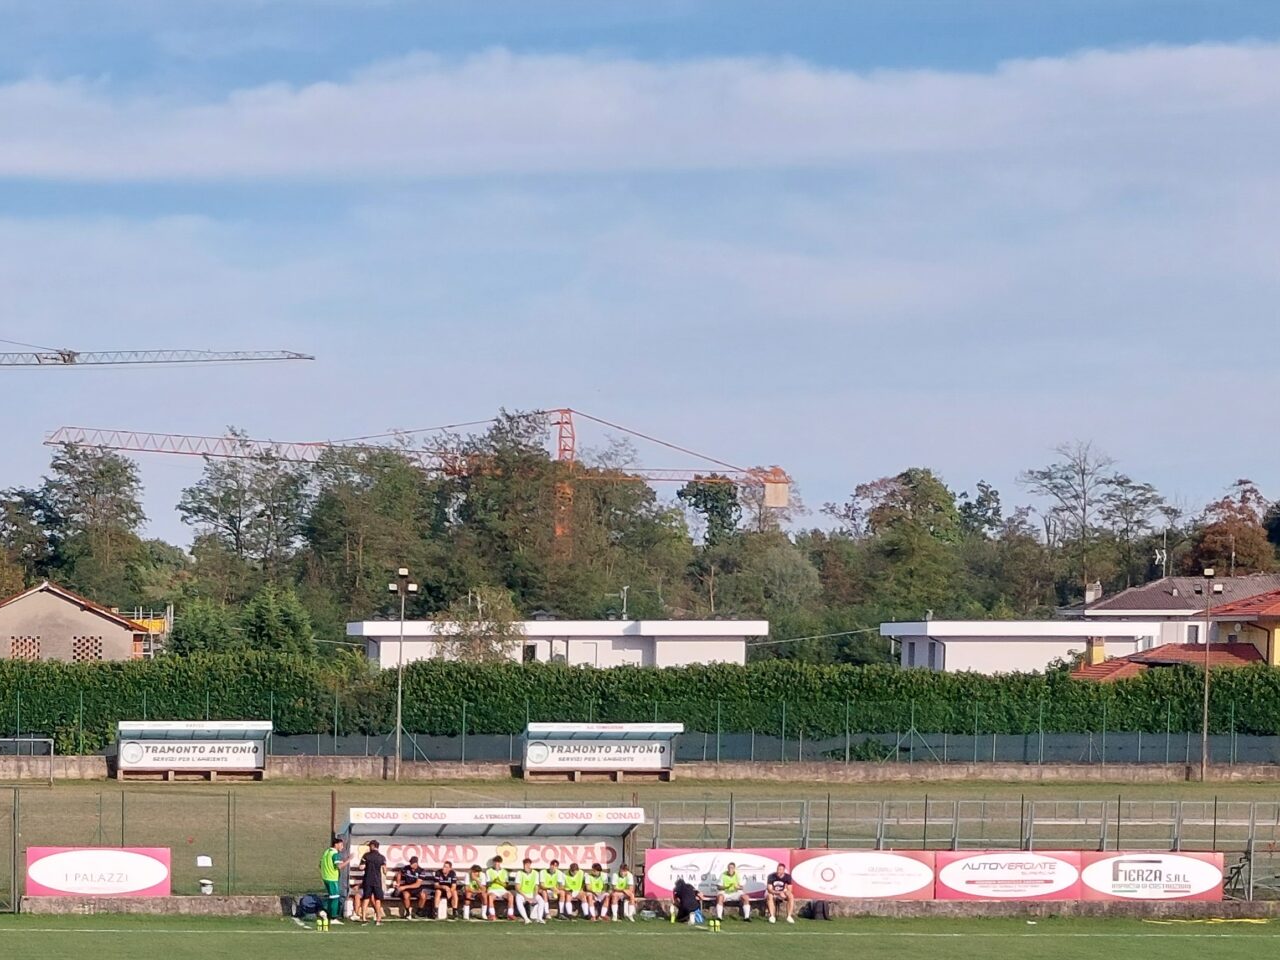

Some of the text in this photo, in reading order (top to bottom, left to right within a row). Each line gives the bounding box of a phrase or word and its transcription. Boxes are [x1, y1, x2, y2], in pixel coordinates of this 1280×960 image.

[145, 745, 258, 754] TRAMONTO ANTONIO
[550, 745, 666, 754] TRAMONTO ANTONIO
[364, 811, 447, 820] CONAD CONAD
[558, 812, 641, 820] CONAD CONAD
[386, 844, 479, 864] CONAD
[524, 844, 617, 865] CONAD
[1112, 860, 1162, 881] FIERZA
[74, 873, 129, 882] PALAZZI
